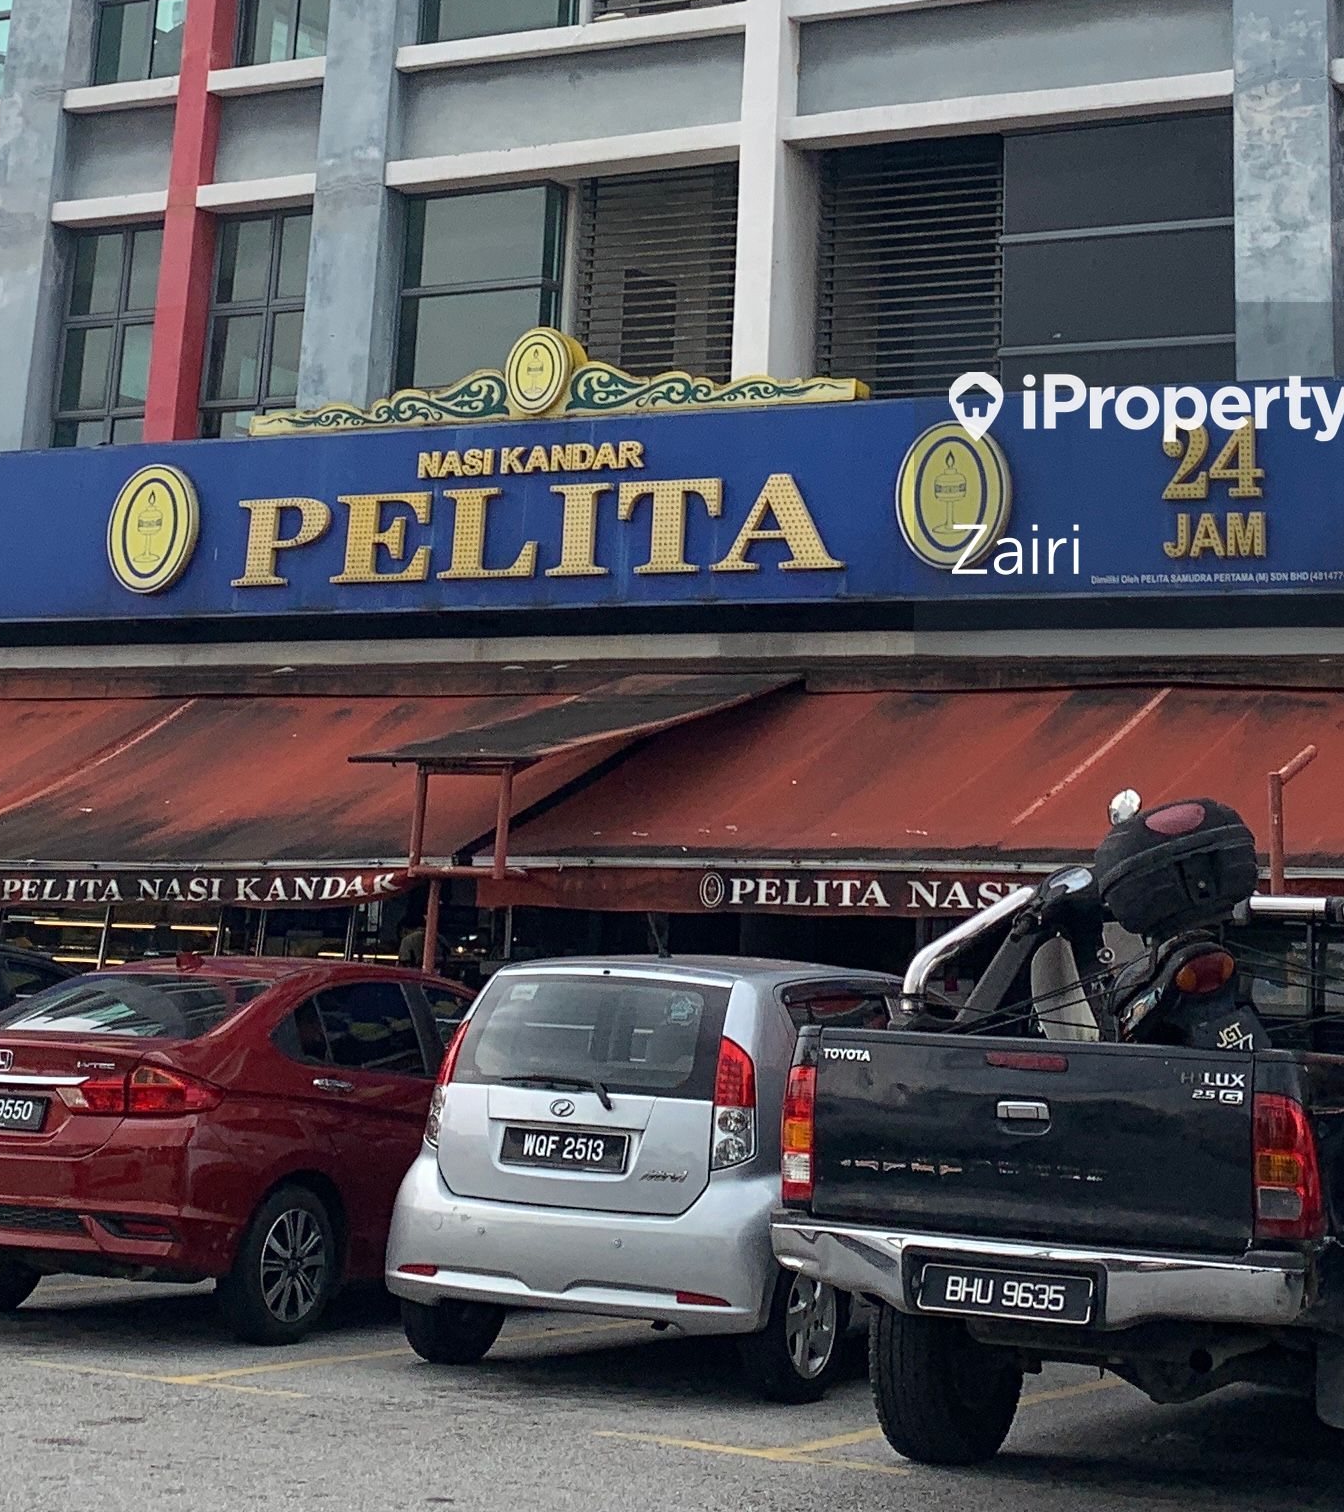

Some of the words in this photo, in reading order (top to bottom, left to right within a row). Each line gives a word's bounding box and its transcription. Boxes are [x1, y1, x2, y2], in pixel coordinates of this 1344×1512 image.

[417, 447, 494, 480] NASI
[500, 440, 644, 476] KANDAR
[1161, 414, 1266, 501] 24
[230, 472, 846, 587] PELITA
[1162, 511, 1267, 559] JAM
[1121, 574, 1140, 584] Oleh
[1140, 574, 1169, 584] PELITA
[1170, 573, 1213, 583] SAMUDRA
[1213, 572, 1255, 583] PERTAMA
[1270, 572, 1289, 582] SDN
[1290, 571, 1309, 582] BHD
[0, 877, 124, 903] PELITA
[136, 877, 223, 903] NASI
[234, 871, 402, 903] KANDAR
[729, 877, 891, 908] PELITA
[822, 1047, 871, 1062] TOYOTA
[522, 1133, 560, 1158] WQF
[562, 1136, 605, 1162] 2513
[944, 1274, 994, 1305] BHU
[1000, 1280, 1066, 1313] 9635
